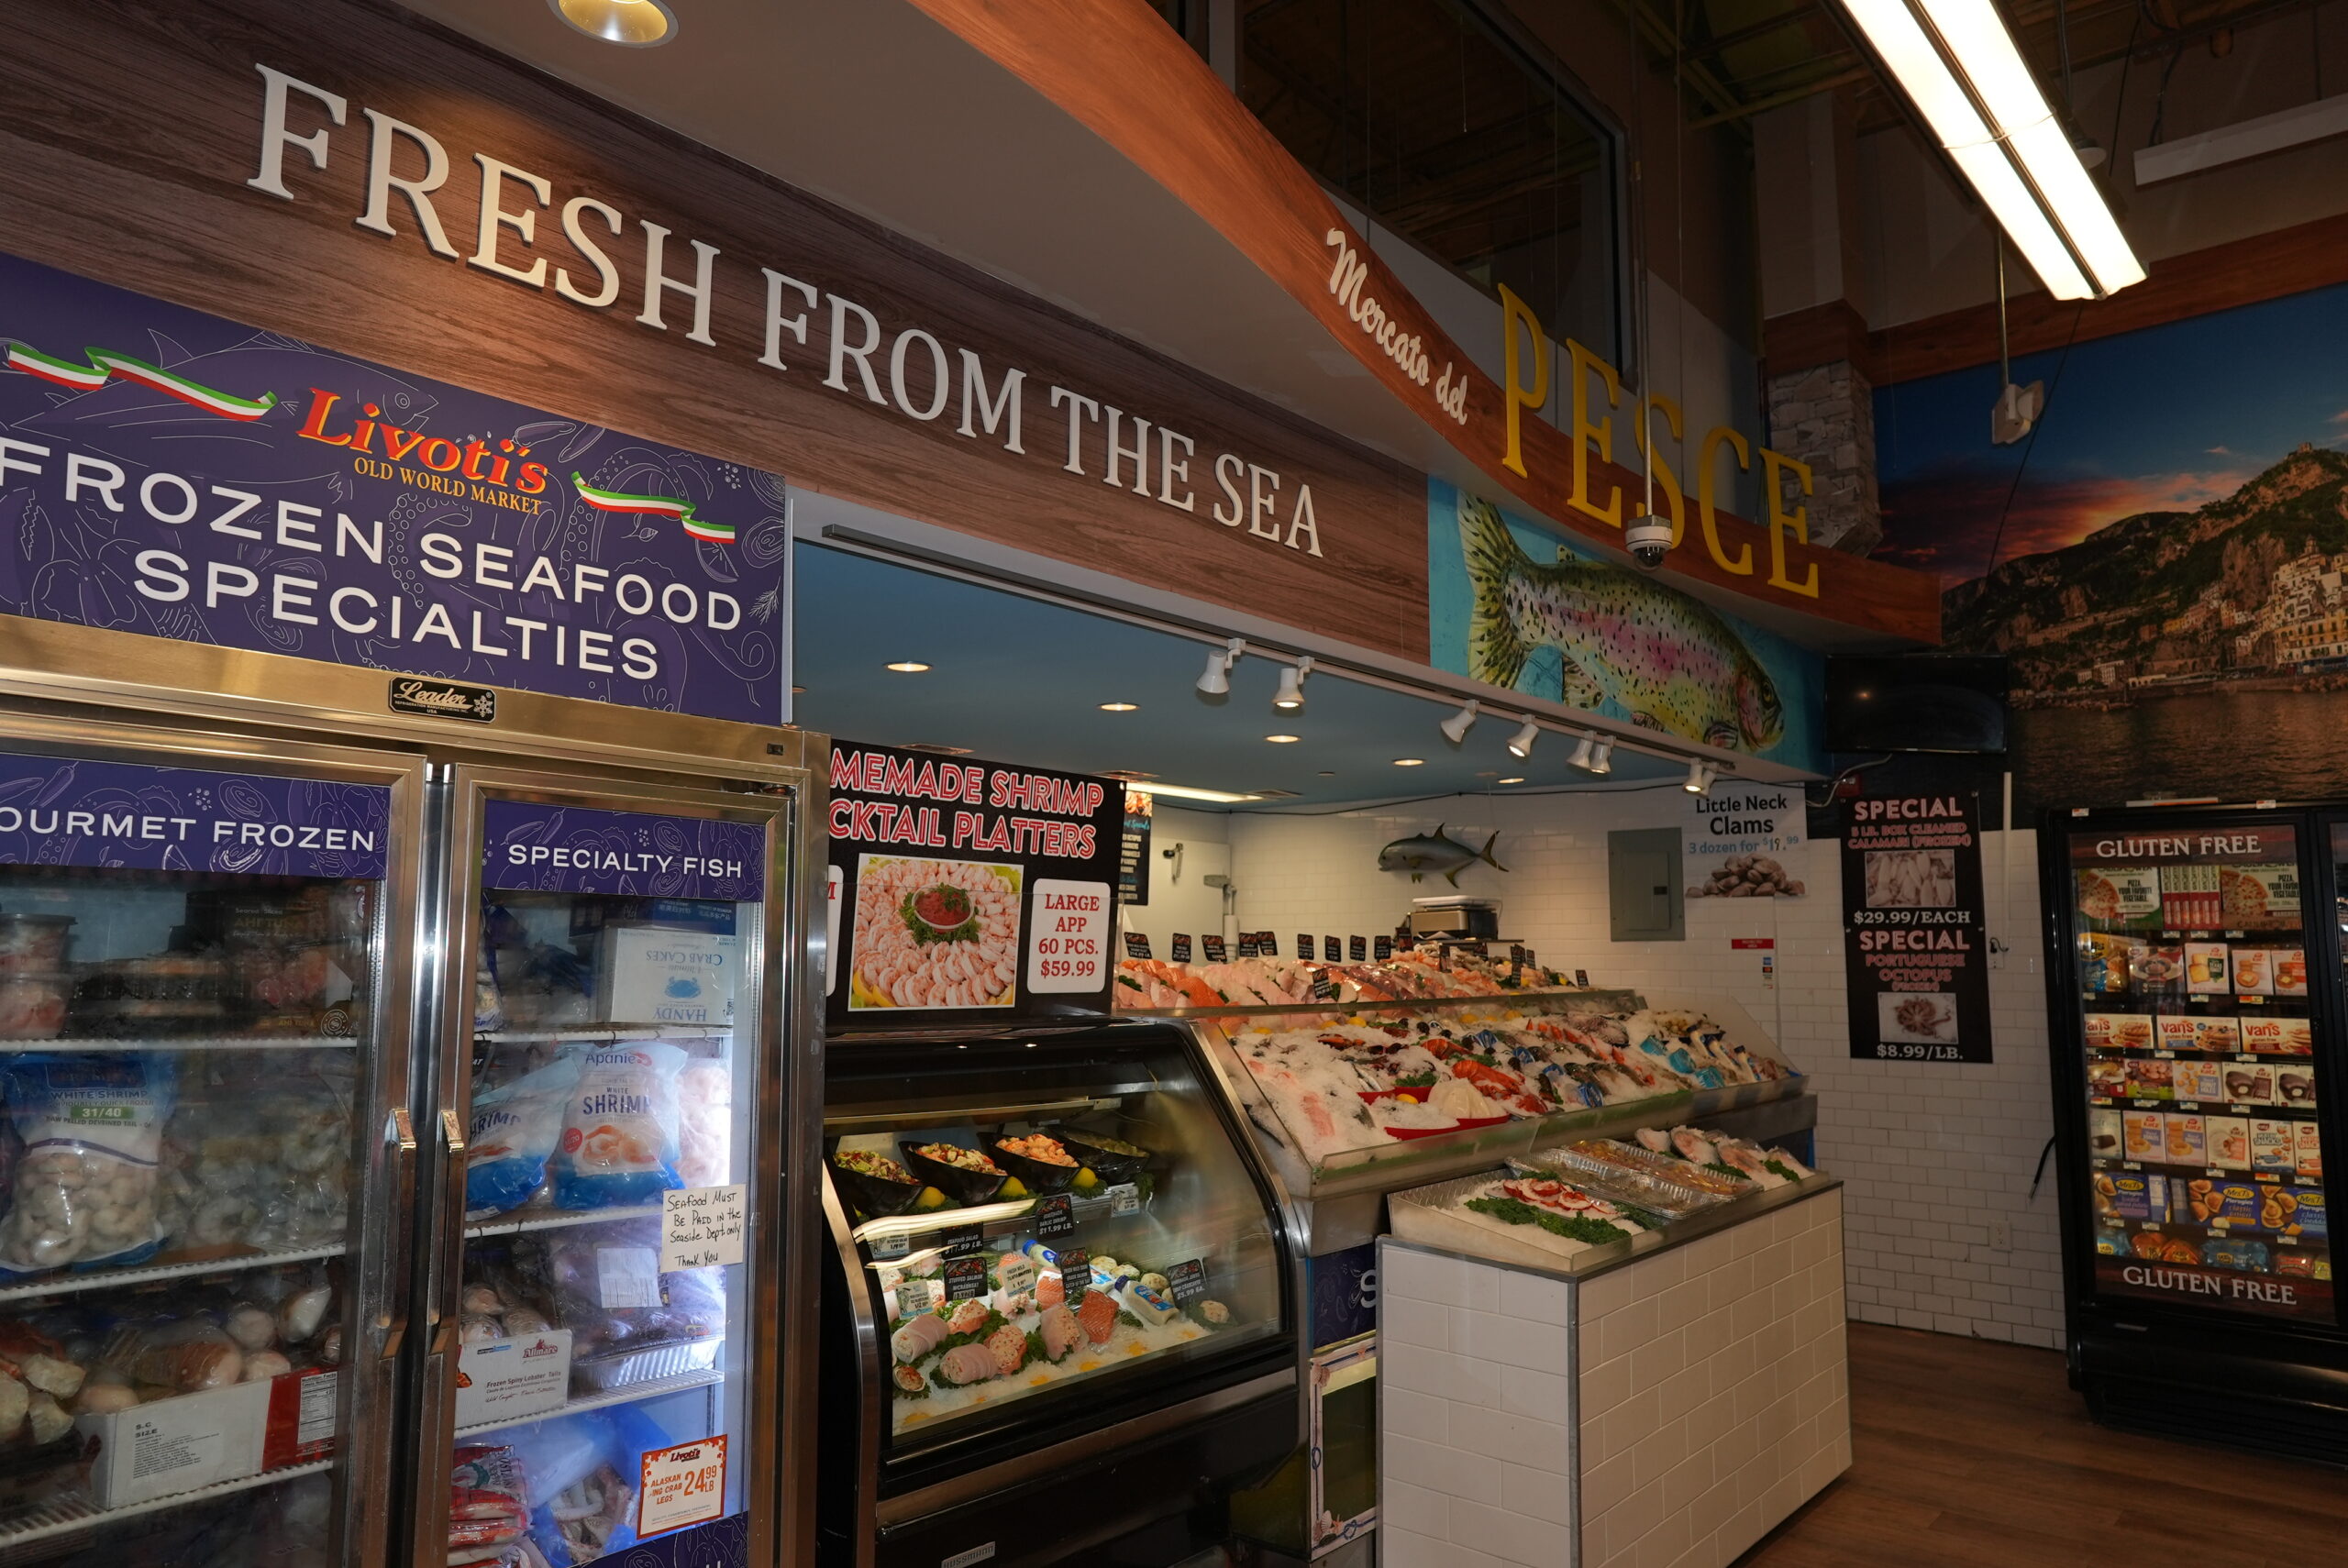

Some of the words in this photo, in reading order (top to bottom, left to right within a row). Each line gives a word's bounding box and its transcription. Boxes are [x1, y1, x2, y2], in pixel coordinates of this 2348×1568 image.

[247, 61, 721, 348] FRESH
[757, 266, 1027, 455] FROM
[1051, 384, 1195, 512] THE
[1213, 452, 1324, 558] SEA
[1326, 226, 1430, 388] Mercato
[1434, 361, 1468, 425] del
[1498, 282, 1820, 600] PESCE
[353, 457, 393, 482] OLD
[400, 465, 466, 501] WORLD
[471, 484, 543, 516] MARKET
[0, 436, 384, 566] FROZEN
[419, 532, 740, 633] SEAFOOD
[133, 549, 659, 680] SPECIALTIES
[393, 681, 473, 710] Leader
[990, 769, 1103, 818] SHRIMP
[1697, 796, 1741, 813] Little
[1745, 793, 1788, 811] Neck
[1854, 796, 1964, 822] SPECIAL
[952, 810, 1097, 859] PLATTERS
[1710, 815, 1774, 835] Clams
[1909, 822, 1967, 835] CLEANED
[214, 820, 375, 852] FROZEN
[1689, 842, 1697, 855] 3
[1700, 840, 1737, 854] dozen
[1741, 838, 1759, 853] for
[2096, 836, 2190, 858] GLUTEN
[2199, 834, 2263, 855] FREE
[508, 844, 673, 874] SPECIALTY
[682, 856, 742, 878] FISH
[1045, 892, 1100, 911] LARGE
[1056, 917, 1087, 933] APP
[1854, 910, 1971, 925] $29.99/EACH
[1038, 938, 1059, 955] 60
[1064, 938, 1099, 955] PCS.
[1858, 928, 1971, 952] SPECIAL
[646, 950, 686, 964] CAKES
[689, 952, 723, 966] CRAB
[1866, 953, 1966, 967] PORTUGUESE
[1040, 960, 1096, 977] $59.99
[1878, 967, 1953, 982] OCTOPUS
[654, 1008, 707, 1021] HANDY
[584, 1052, 637, 1066] Apanie
[1877, 1044, 1964, 1061] $8.99/LB.
[50, 1090, 94, 1099] WHITE
[97, 1089, 148, 1099] SHRIMP
[606, 1086, 630, 1095] WHITE
[82, 1108, 122, 1118] 31/40
[582, 1094, 651, 1116] SHRIMP
[674, 1213, 686, 1227] BE
[692, 1209, 712, 1226] PAID
[716, 1211, 725, 1222] IN
[726, 1207, 741, 1220] the
[670, 1228, 703, 1243] Seaside
[726, 1221, 741, 1242] only
[971, 1241, 983, 1249] LB.
[703, 1249, 718, 1267] You
[2122, 1265, 2221, 1297] GLUTEN
[2231, 1277, 2298, 1306] FREE
[486, 1380, 507, 1388] Frozen
[507, 1377, 523, 1386] Spiny
[524, 1373, 547, 1382] Lobster
[648, 1487, 663, 1498] ING
[664, 1482, 682, 1494] CRAB
[704, 1479, 714, 1493] LB
[650, 1473, 681, 1487] ALASKAN
[683, 1467, 705, 1496] 24
[705, 1464, 717, 1480] 99
[657, 1494, 673, 1505] LEGS
